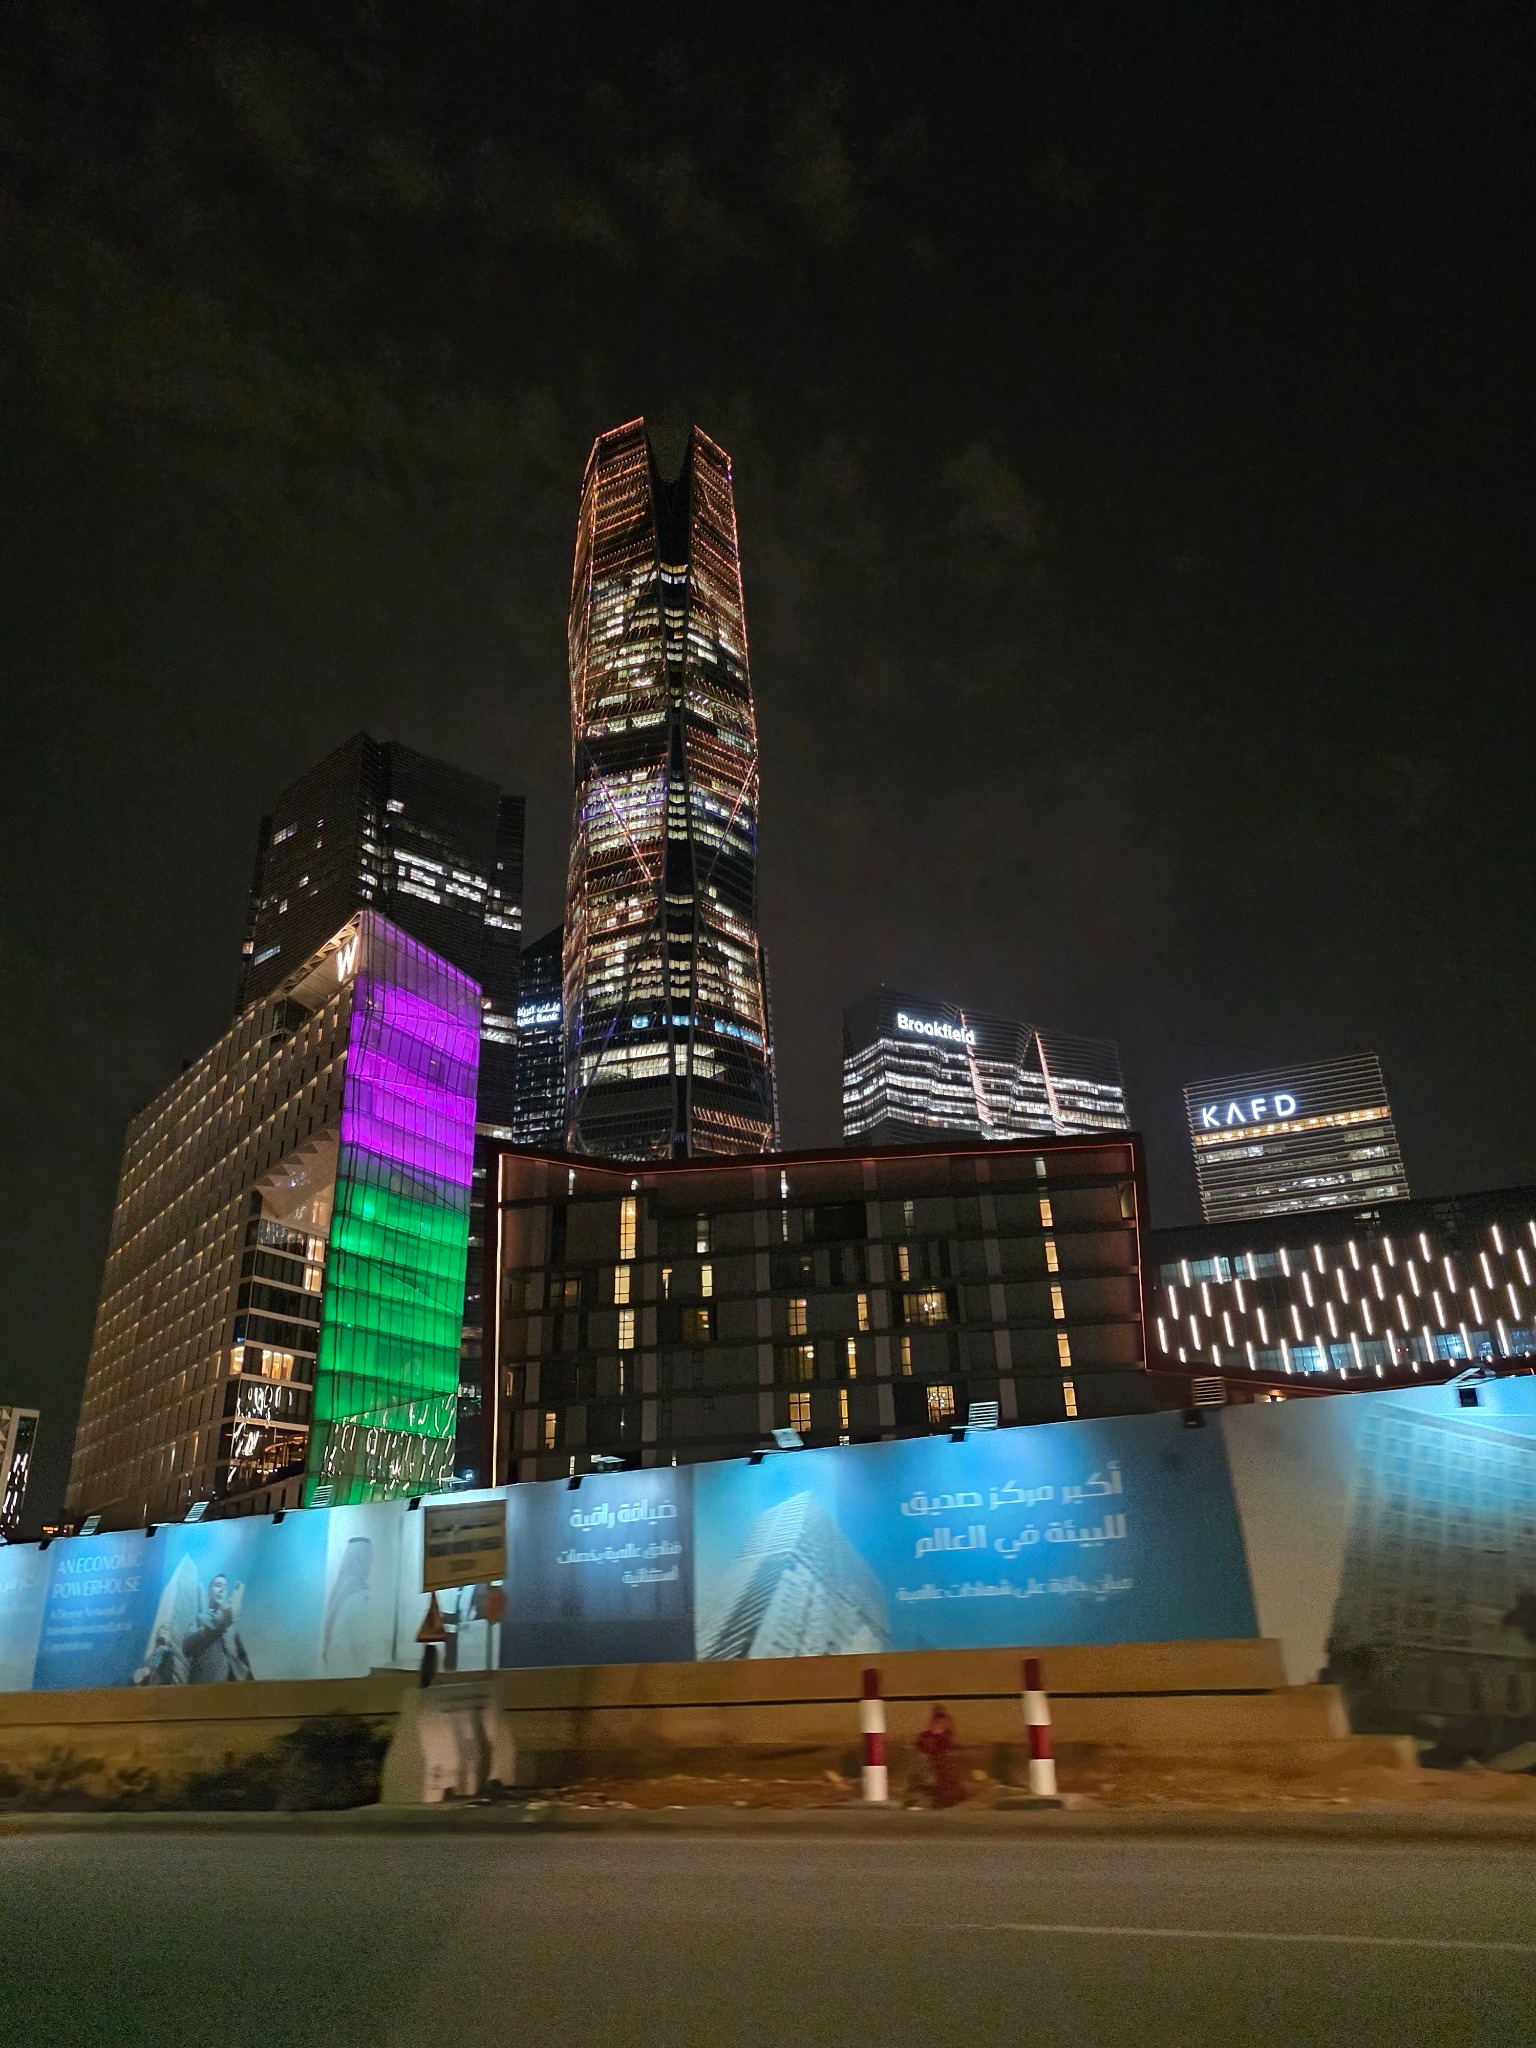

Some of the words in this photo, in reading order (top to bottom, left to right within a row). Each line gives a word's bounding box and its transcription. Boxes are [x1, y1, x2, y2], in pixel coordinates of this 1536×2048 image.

[335, 934, 359, 983] W
[536, 1012, 560, 1023] Bank
[897, 1012, 976, 1046] Brookfield
[1202, 1094, 1297, 1128] KAFD
[988, 1479, 1055, 1511] مركز
[1061, 1460, 1124, 1505] أكبر
[569, 1502, 616, 1532] راقية
[617, 1498, 678, 1526] ضيافة
[900, 1490, 984, 1518] صديق
[914, 1524, 988, 1559] العالم
[993, 1523, 1041, 1560] في
[1044, 1513, 1128, 1548] للبيئة
[52, 1576, 142, 1600] POWERHOUSE
